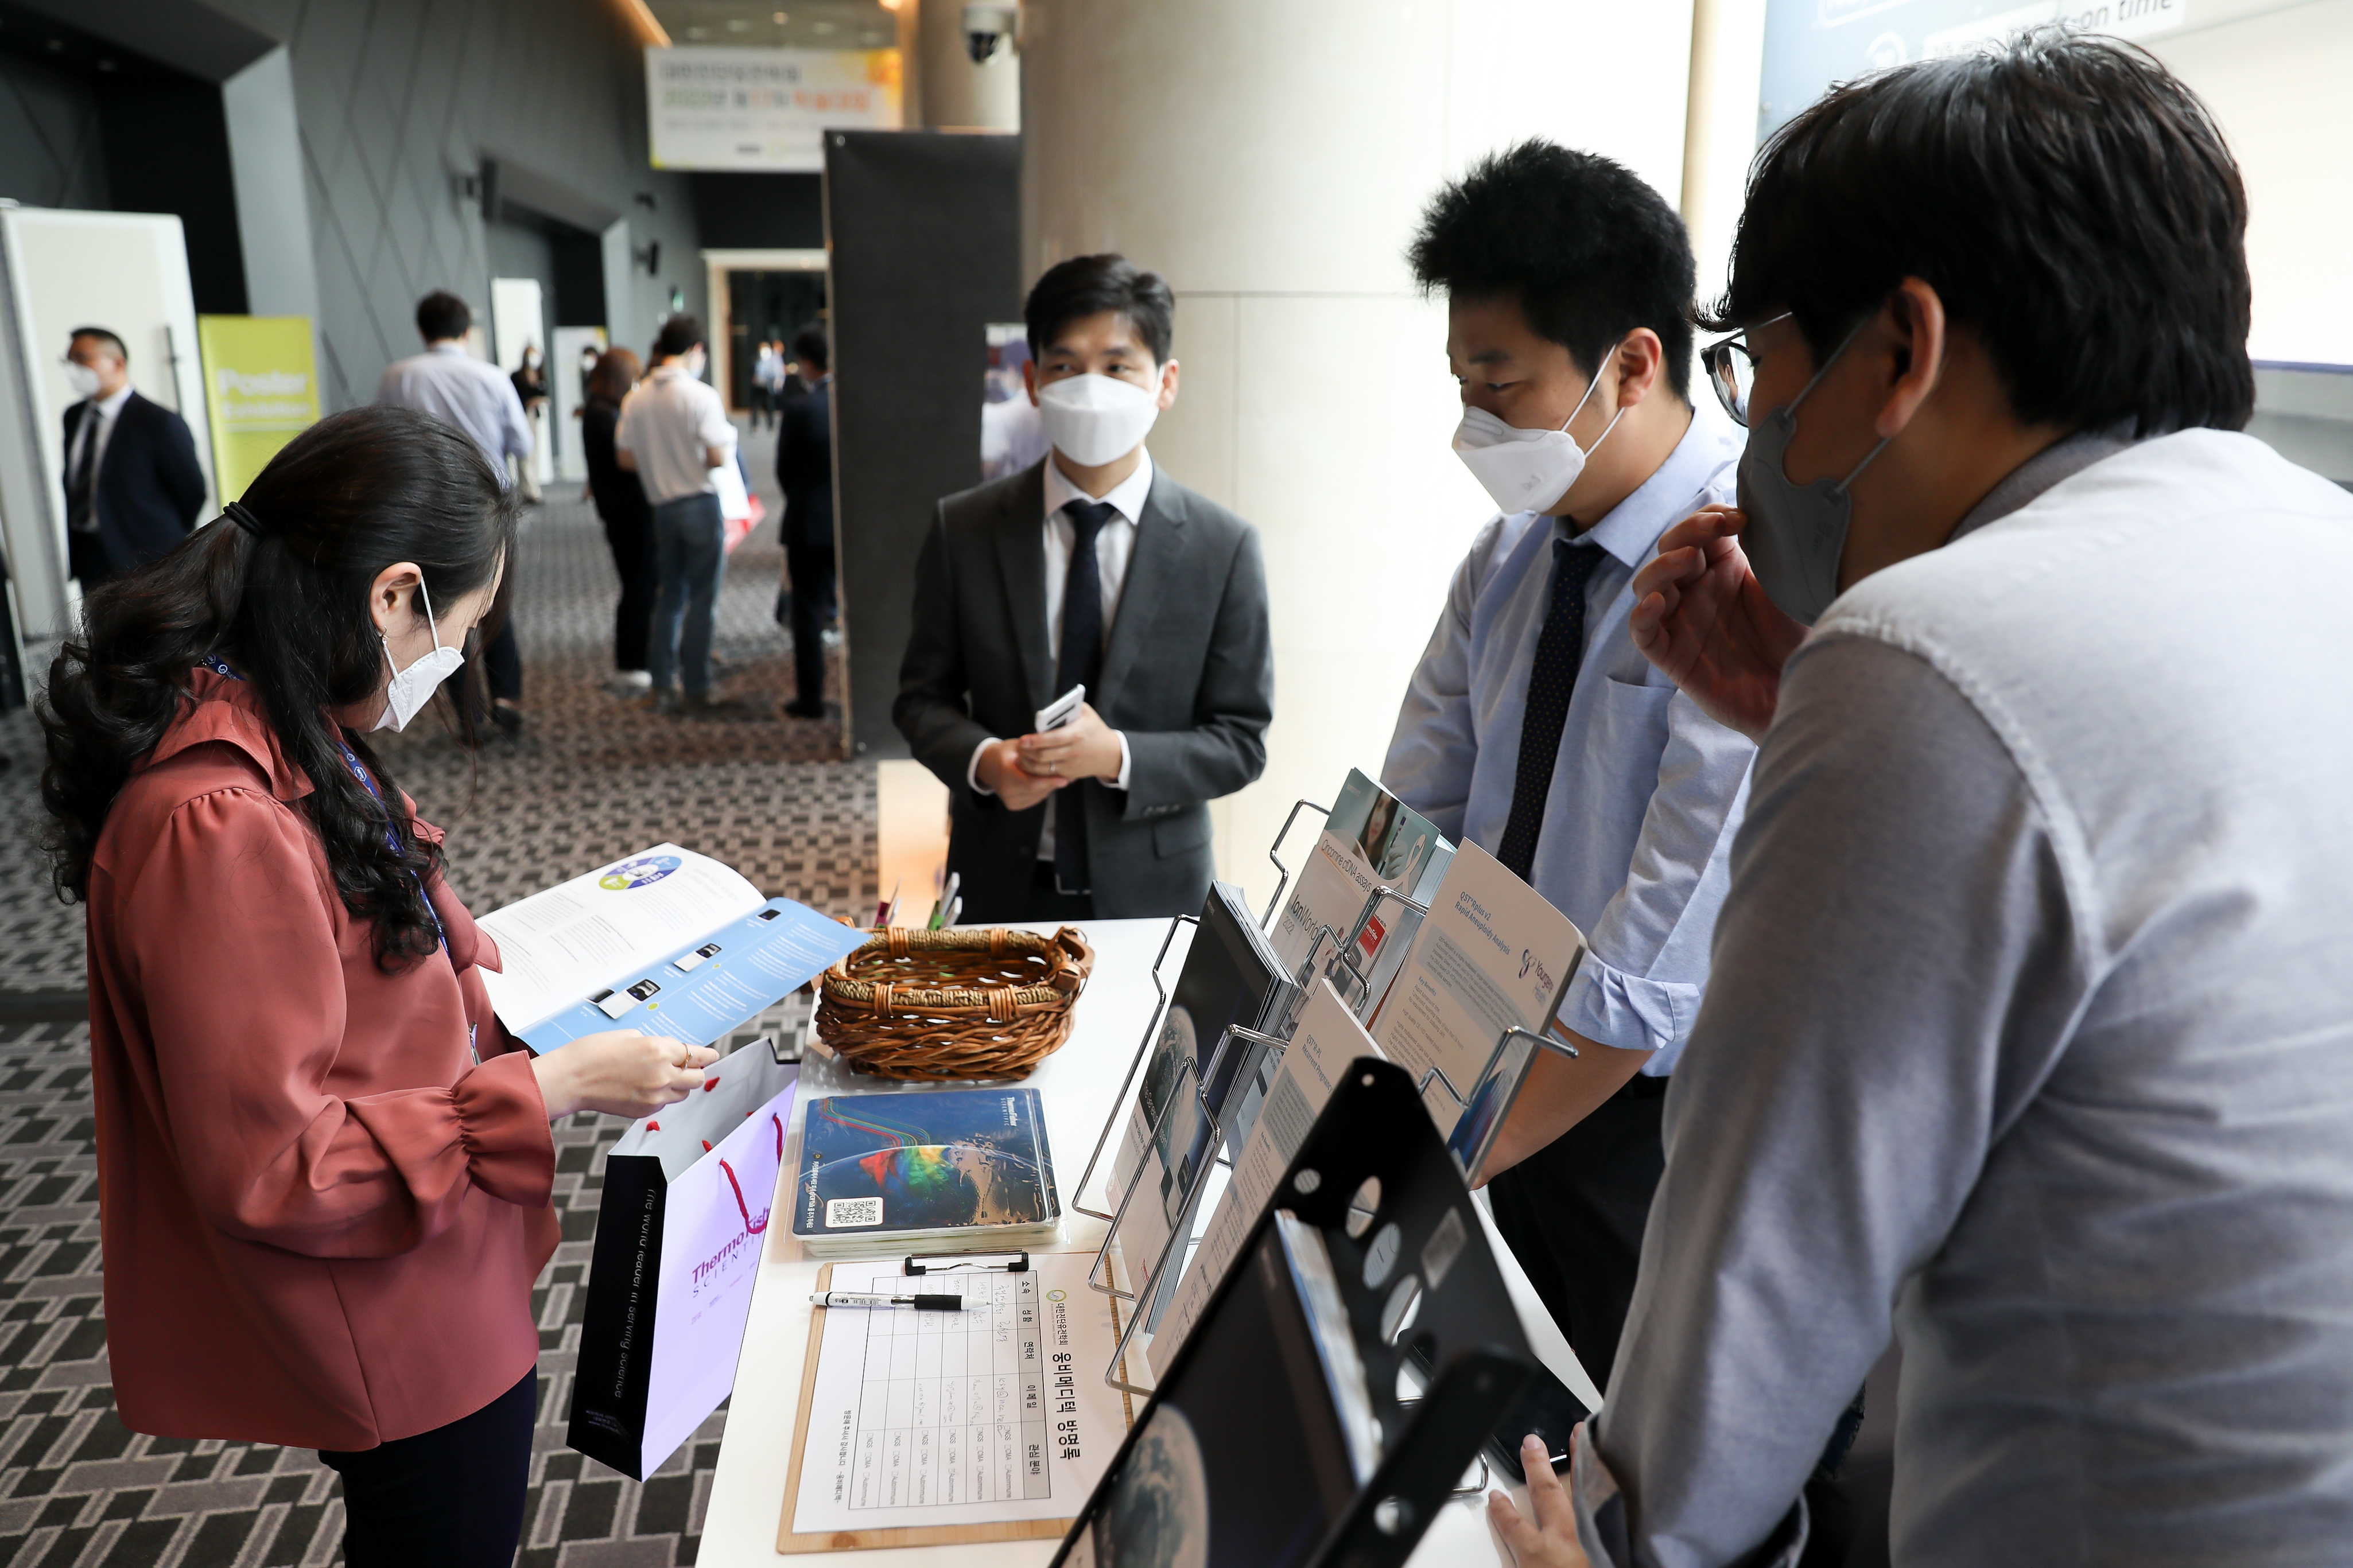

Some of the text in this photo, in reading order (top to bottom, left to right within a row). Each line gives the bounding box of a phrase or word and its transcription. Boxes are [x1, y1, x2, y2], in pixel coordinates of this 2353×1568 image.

[218, 369, 308, 396] Poster
[1322, 840, 1344, 865] Oncomine
[1356, 873, 1372, 892] assays
[1283, 916, 1294, 935] 2022
[1290, 894, 1319, 941] IonWorld
[1455, 901, 1510, 955] Rapid Aneuploidy Analysis
[1484, 912, 1491, 921] v2
[1364, 928, 1376, 945] CIENTIFIC
[1366, 924, 1379, 941] ermoFisher
[1424, 982, 1436, 996] Benefits
[1535, 960, 1554, 994] Yourgene
[1302, 1044, 1333, 1093] Recurrent Pregnancy
[1000, 1097, 1009, 1126] SCIENTIFIC
[1159, 1127, 1167, 1149] stem
[620, 1306, 636, 1350] serving
[1024, 1341, 1034, 1359] 연락처
[615, 1352, 629, 1398] science
[1052, 1303, 1080, 1460] 대한진단유전학회 웅비메디텍 방명록
[842, 1410, 851, 1424] 방문해
[841, 1425, 849, 1439] 주셔서
[838, 1441, 848, 1466] 감사합니다
[1028, 1444, 1040, 1474] 관심 분야
[860, 1477, 868, 1506] Autoimmune
